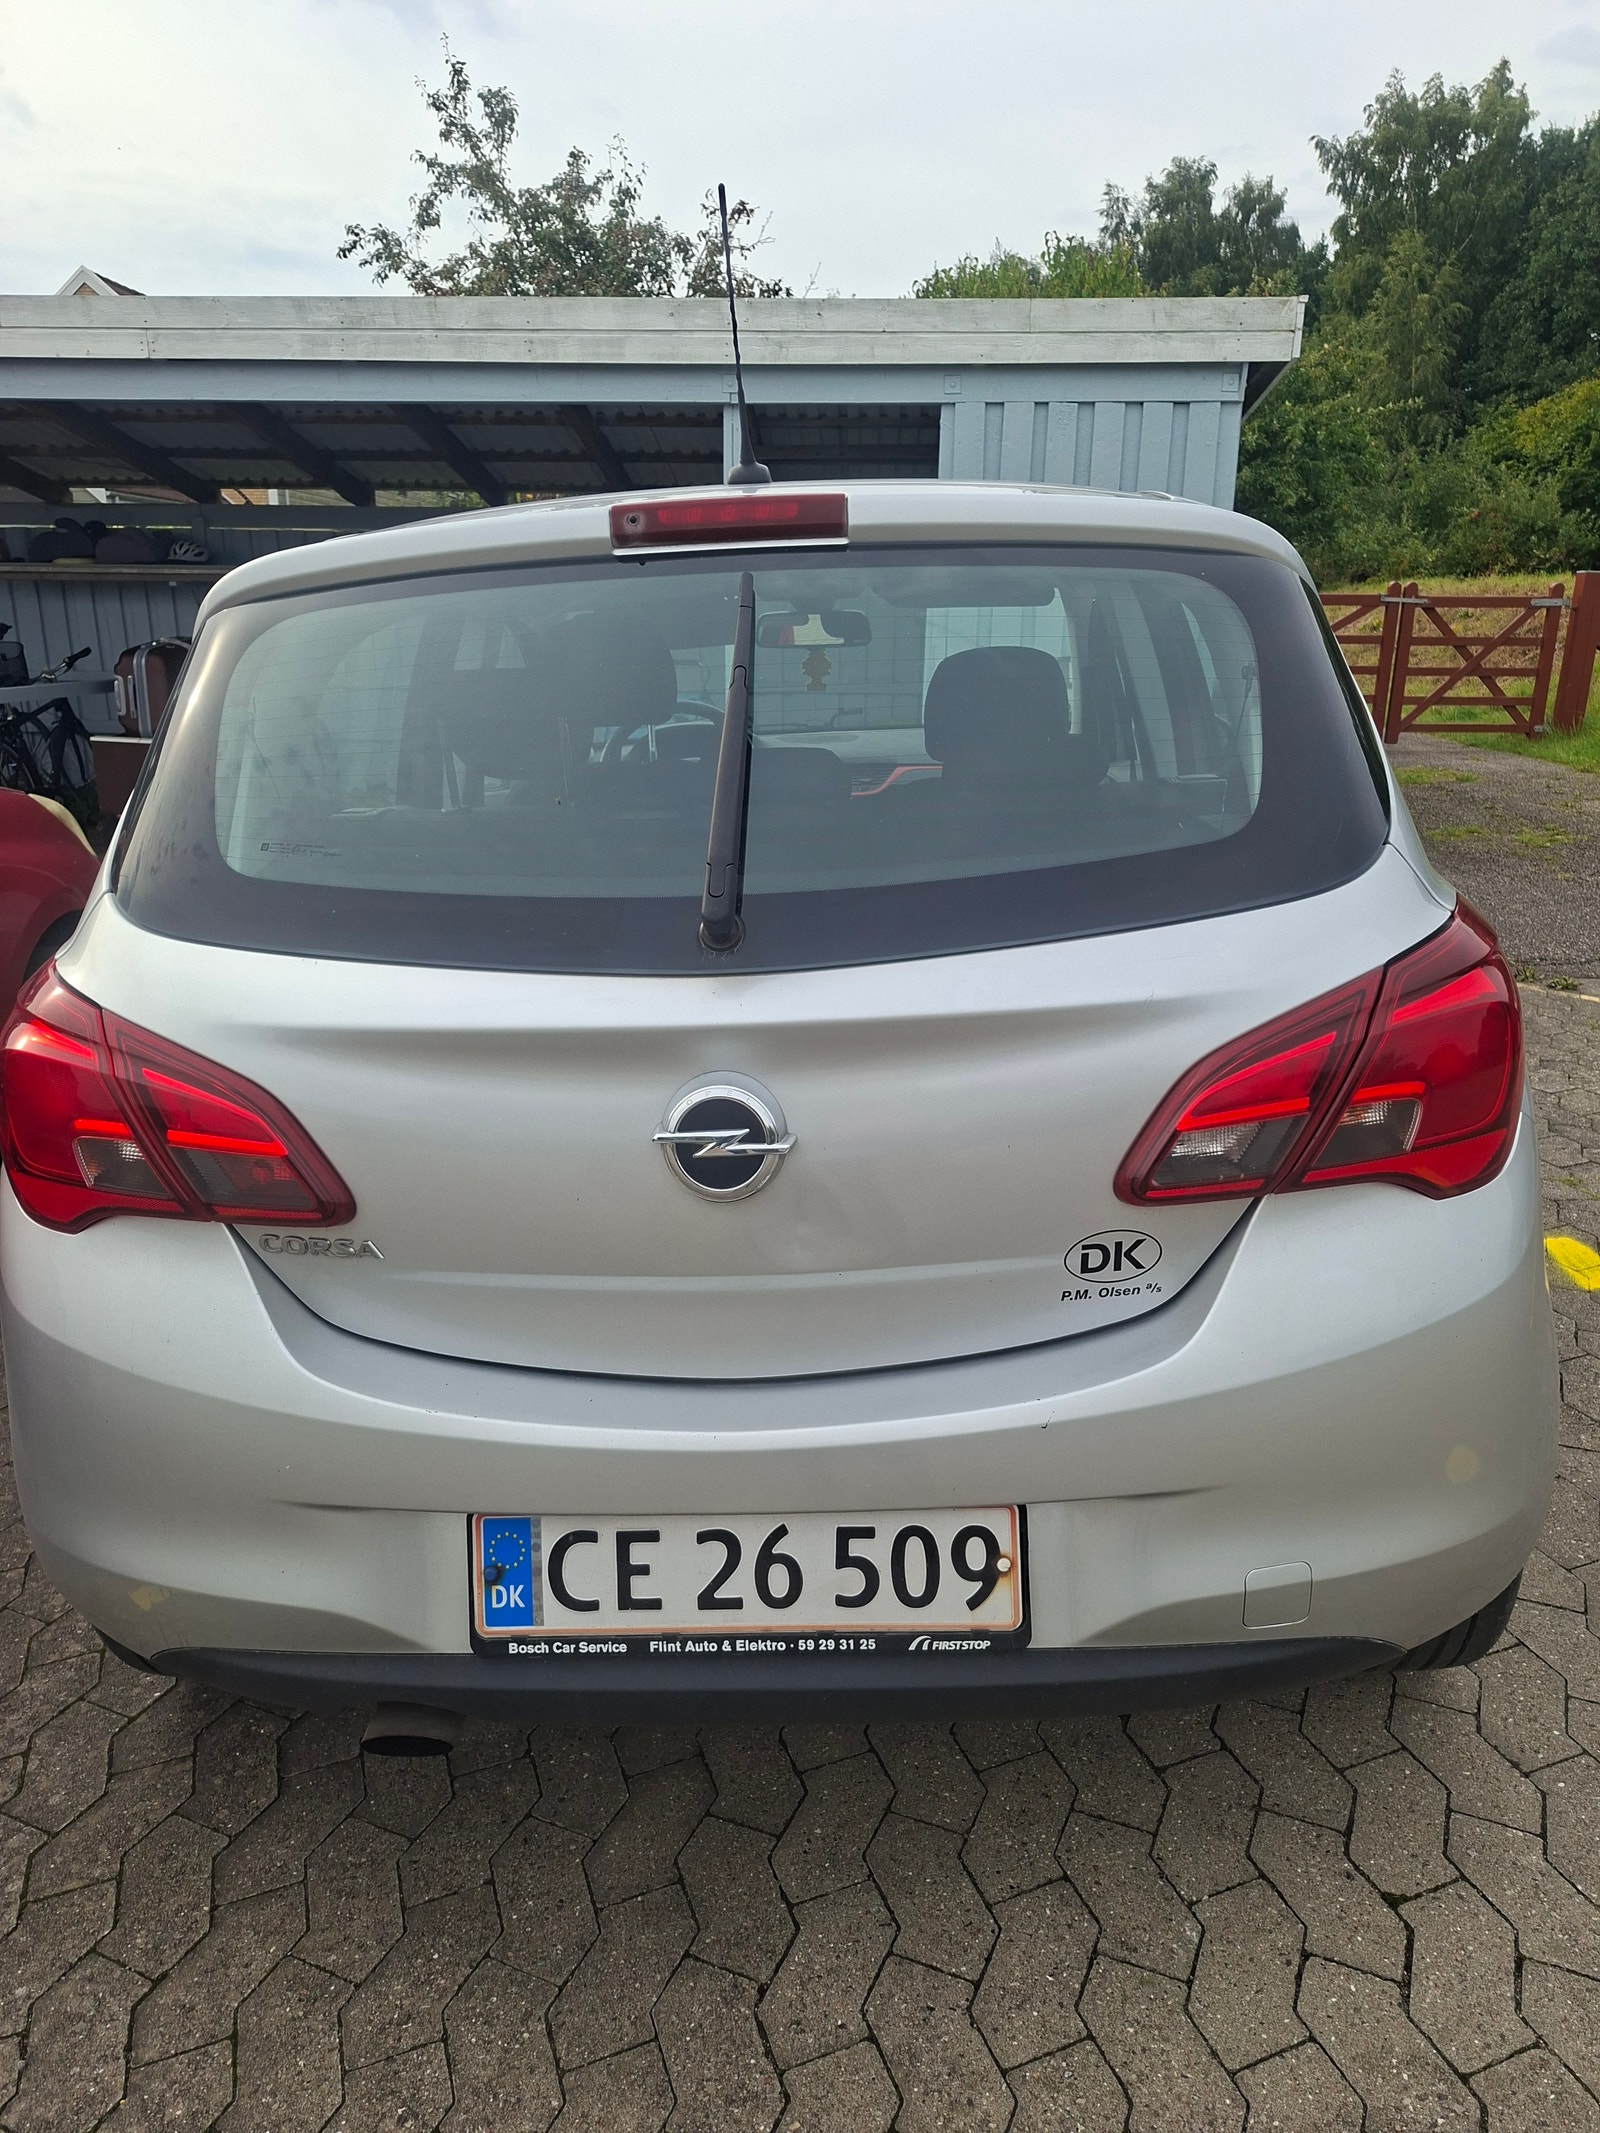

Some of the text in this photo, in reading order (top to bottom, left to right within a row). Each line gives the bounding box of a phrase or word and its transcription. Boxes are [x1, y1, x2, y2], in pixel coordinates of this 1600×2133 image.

[686, 1090, 753, 1106] OPEL
[259, 1233, 385, 1259] CORSA
[1080, 1238, 1147, 1274] DK
[1060, 1289, 1093, 1301] P.M.
[1098, 1286, 1141, 1298] Olsen
[547, 1523, 1001, 1612] CE 26 509
[491, 1584, 525, 1608] DK
[508, 1641, 628, 1654] Bosch Car Service
[649, 1638, 876, 1652] Flint Auto & Elektro 59 29 31 25
[932, 1640, 991, 1650] FIRSTSTOP
